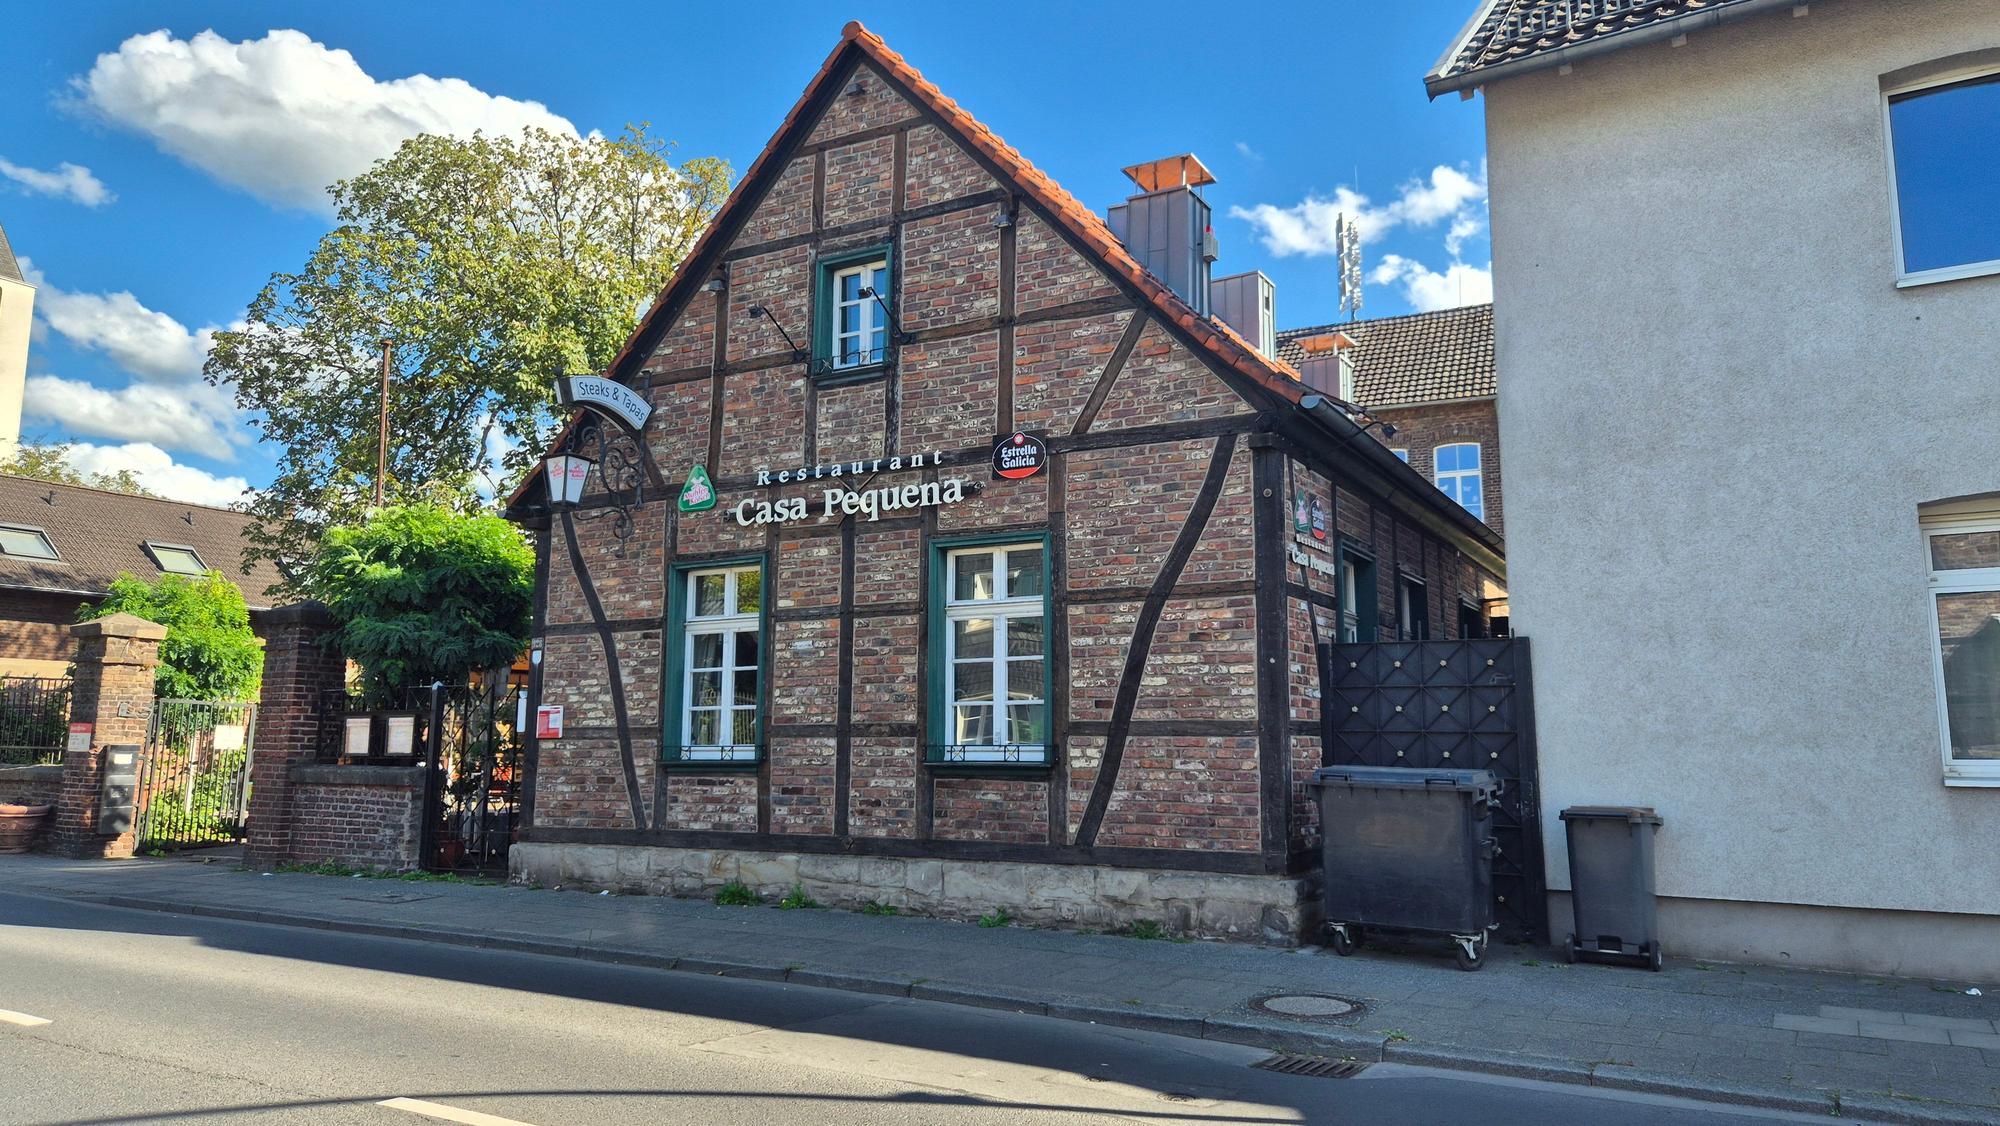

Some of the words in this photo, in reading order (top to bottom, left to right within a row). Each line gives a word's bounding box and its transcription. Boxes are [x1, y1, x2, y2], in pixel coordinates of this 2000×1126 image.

[579, 382, 610, 398] Steaks
[612, 387, 620, 401] &
[622, 392, 646, 421] Tapas
[757, 450, 944, 486] Restaurant
[1001, 444, 1037, 458] Estrella
[1002, 455, 1036, 469] Galicia
[736, 497, 809, 527] Casa
[822, 478, 965, 522] Pequena
